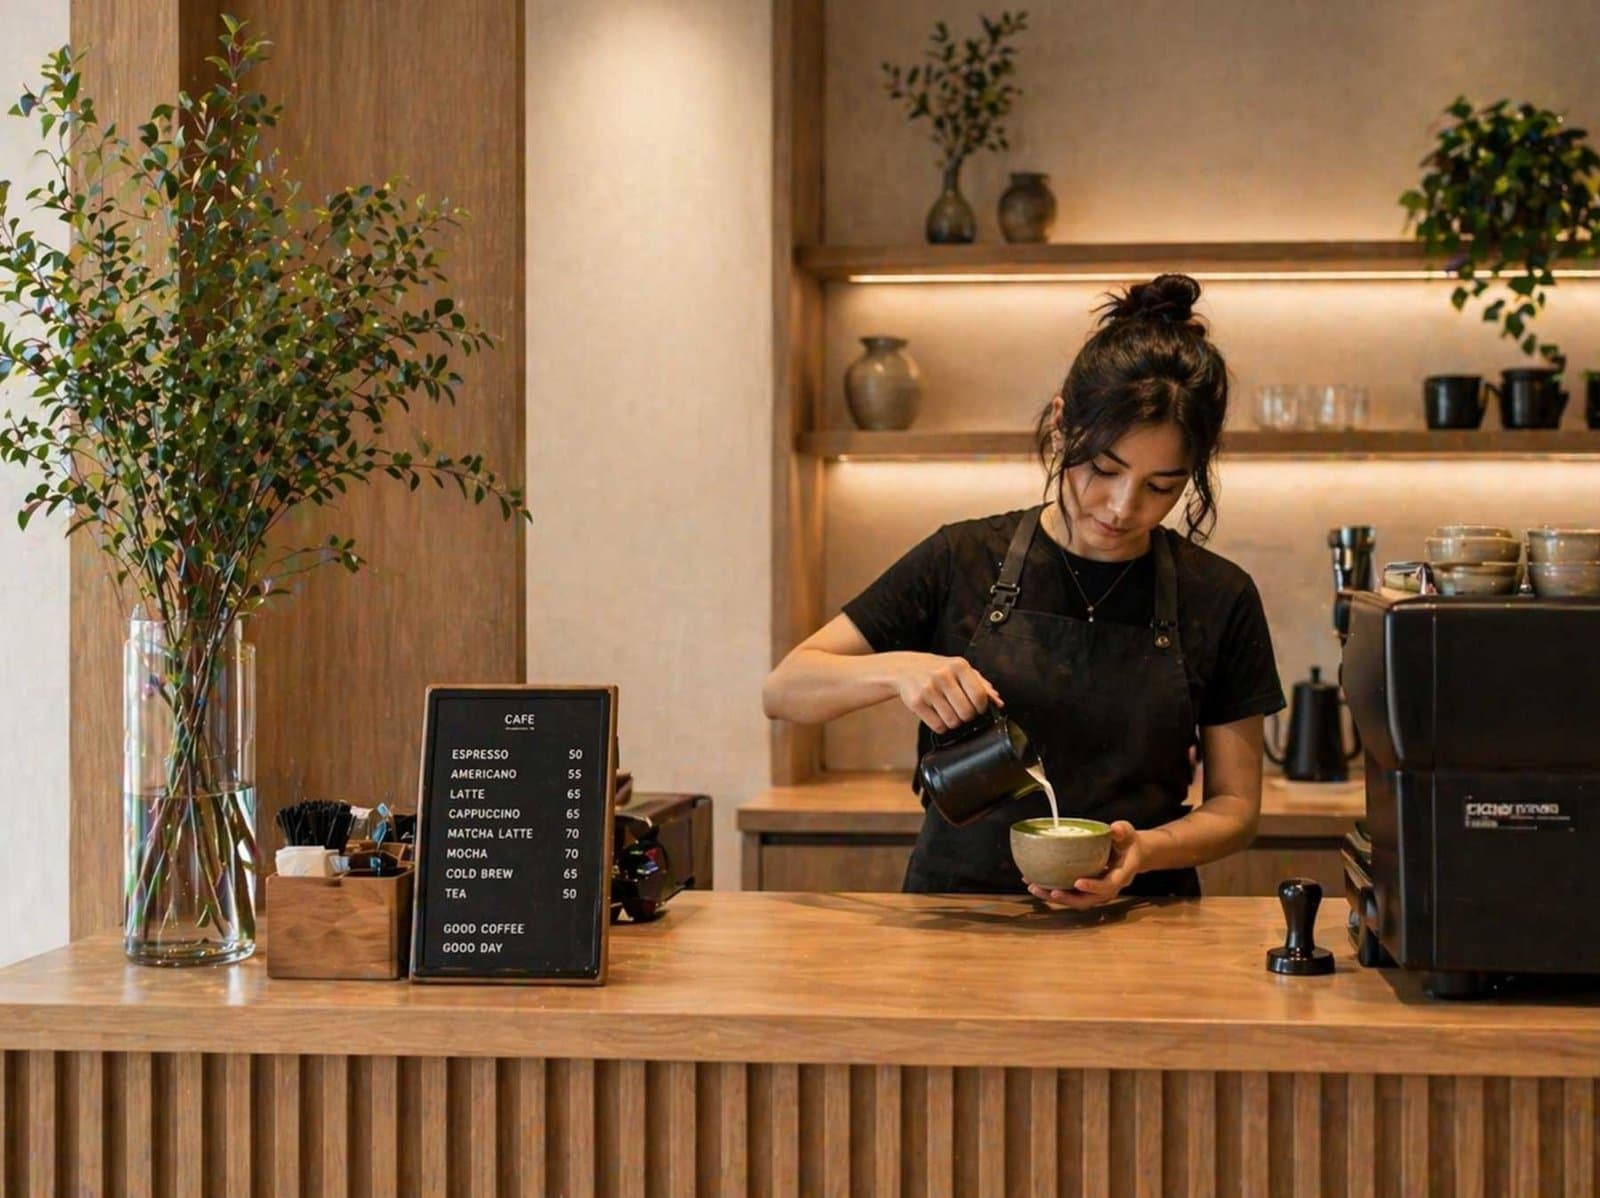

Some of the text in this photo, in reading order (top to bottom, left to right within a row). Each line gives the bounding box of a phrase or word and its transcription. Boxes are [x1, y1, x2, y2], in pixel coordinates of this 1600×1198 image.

[504, 713, 535, 725] CAFE
[451, 748, 583, 760] ESPRESSO 50
[450, 768, 582, 780] AMERICANO 55
[449, 788, 581, 800] LATTE 65
[448, 808, 581, 820] CAPPUCCINO 65
[447, 828, 580, 840] MATCHA LATTE 70
[446, 847, 579, 859] MOCHA 70
[445, 868, 578, 880] COLD BREW 65
[444, 887, 577, 900] TEA 50
[443, 922, 525, 934] GOOD COFFEE
[480, 942, 503, 954] DAY
